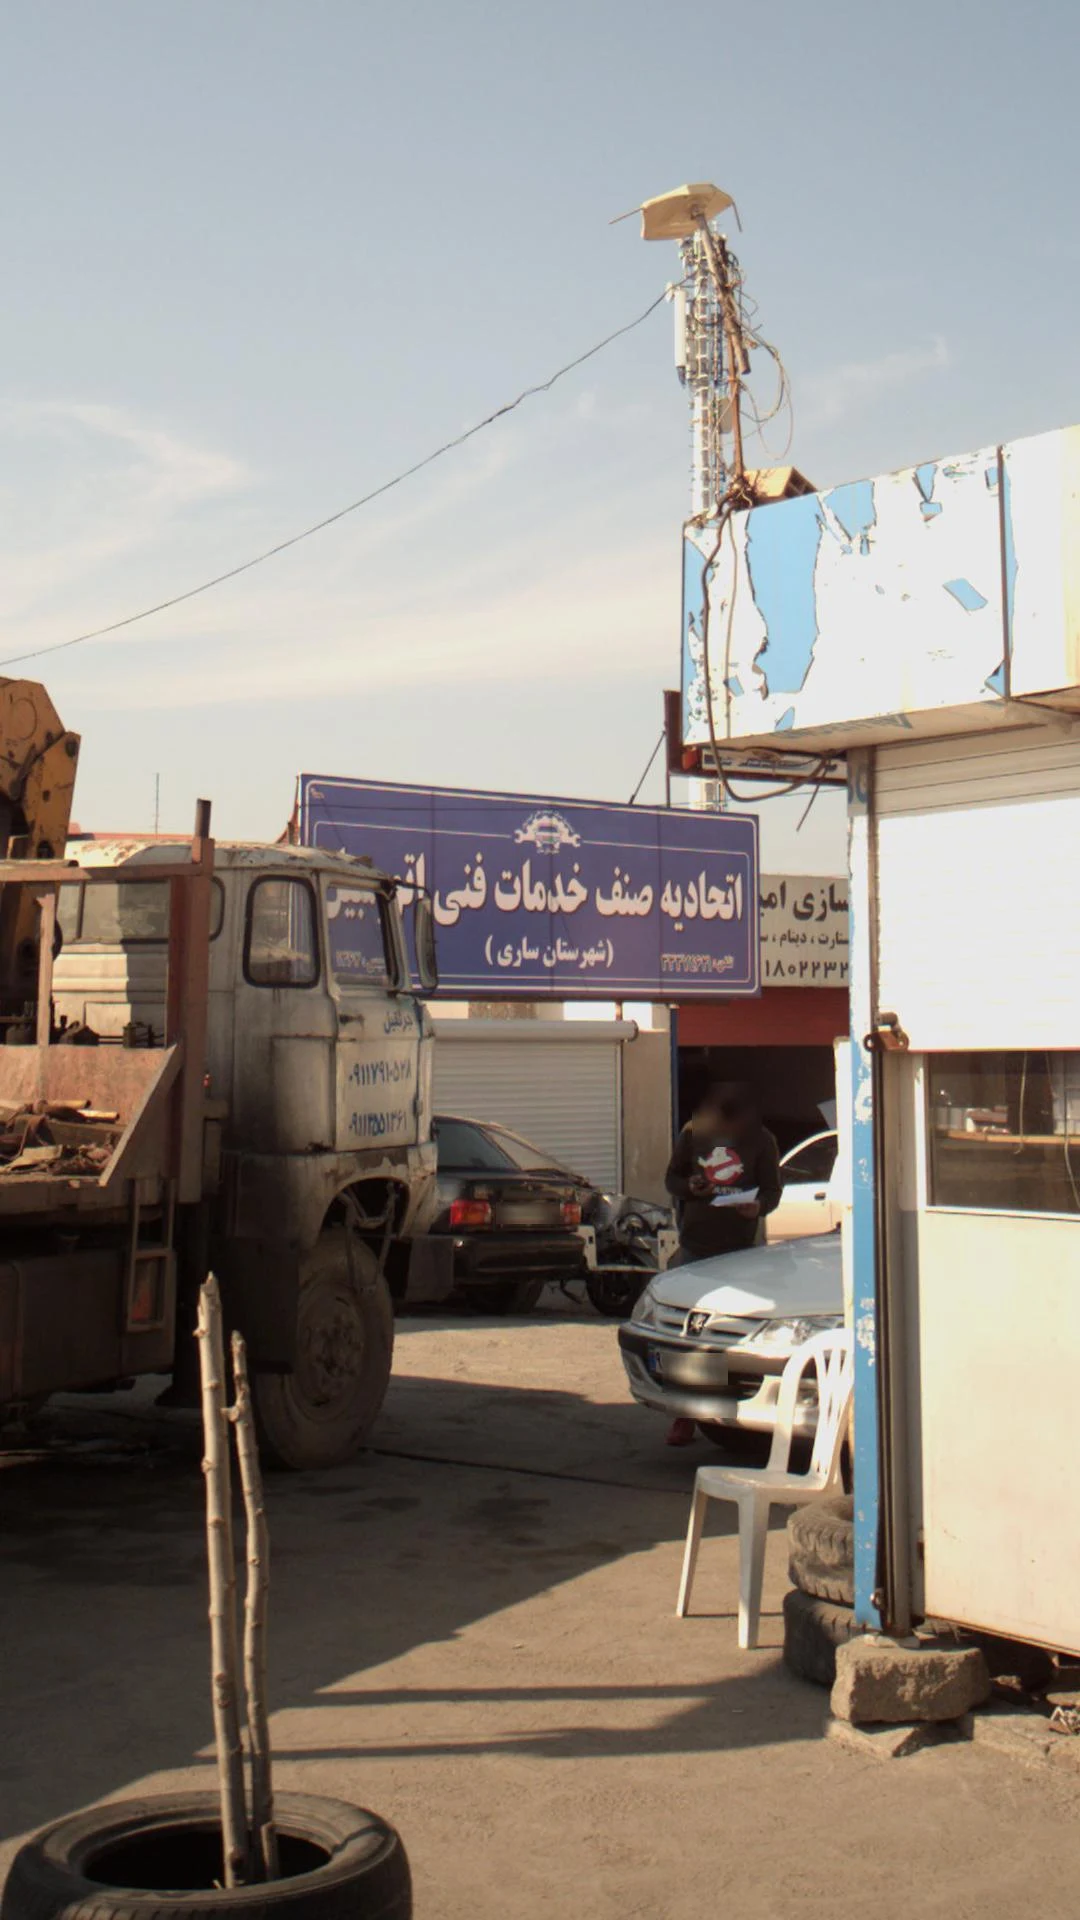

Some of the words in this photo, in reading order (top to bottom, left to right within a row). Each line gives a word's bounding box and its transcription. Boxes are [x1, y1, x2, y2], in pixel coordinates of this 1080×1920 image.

[433, 852, 487, 926] فنی
[494, 859, 588, 913] خدمات
[595, 866, 653, 916] صنف
[660, 871, 743, 932] اتحادیه
